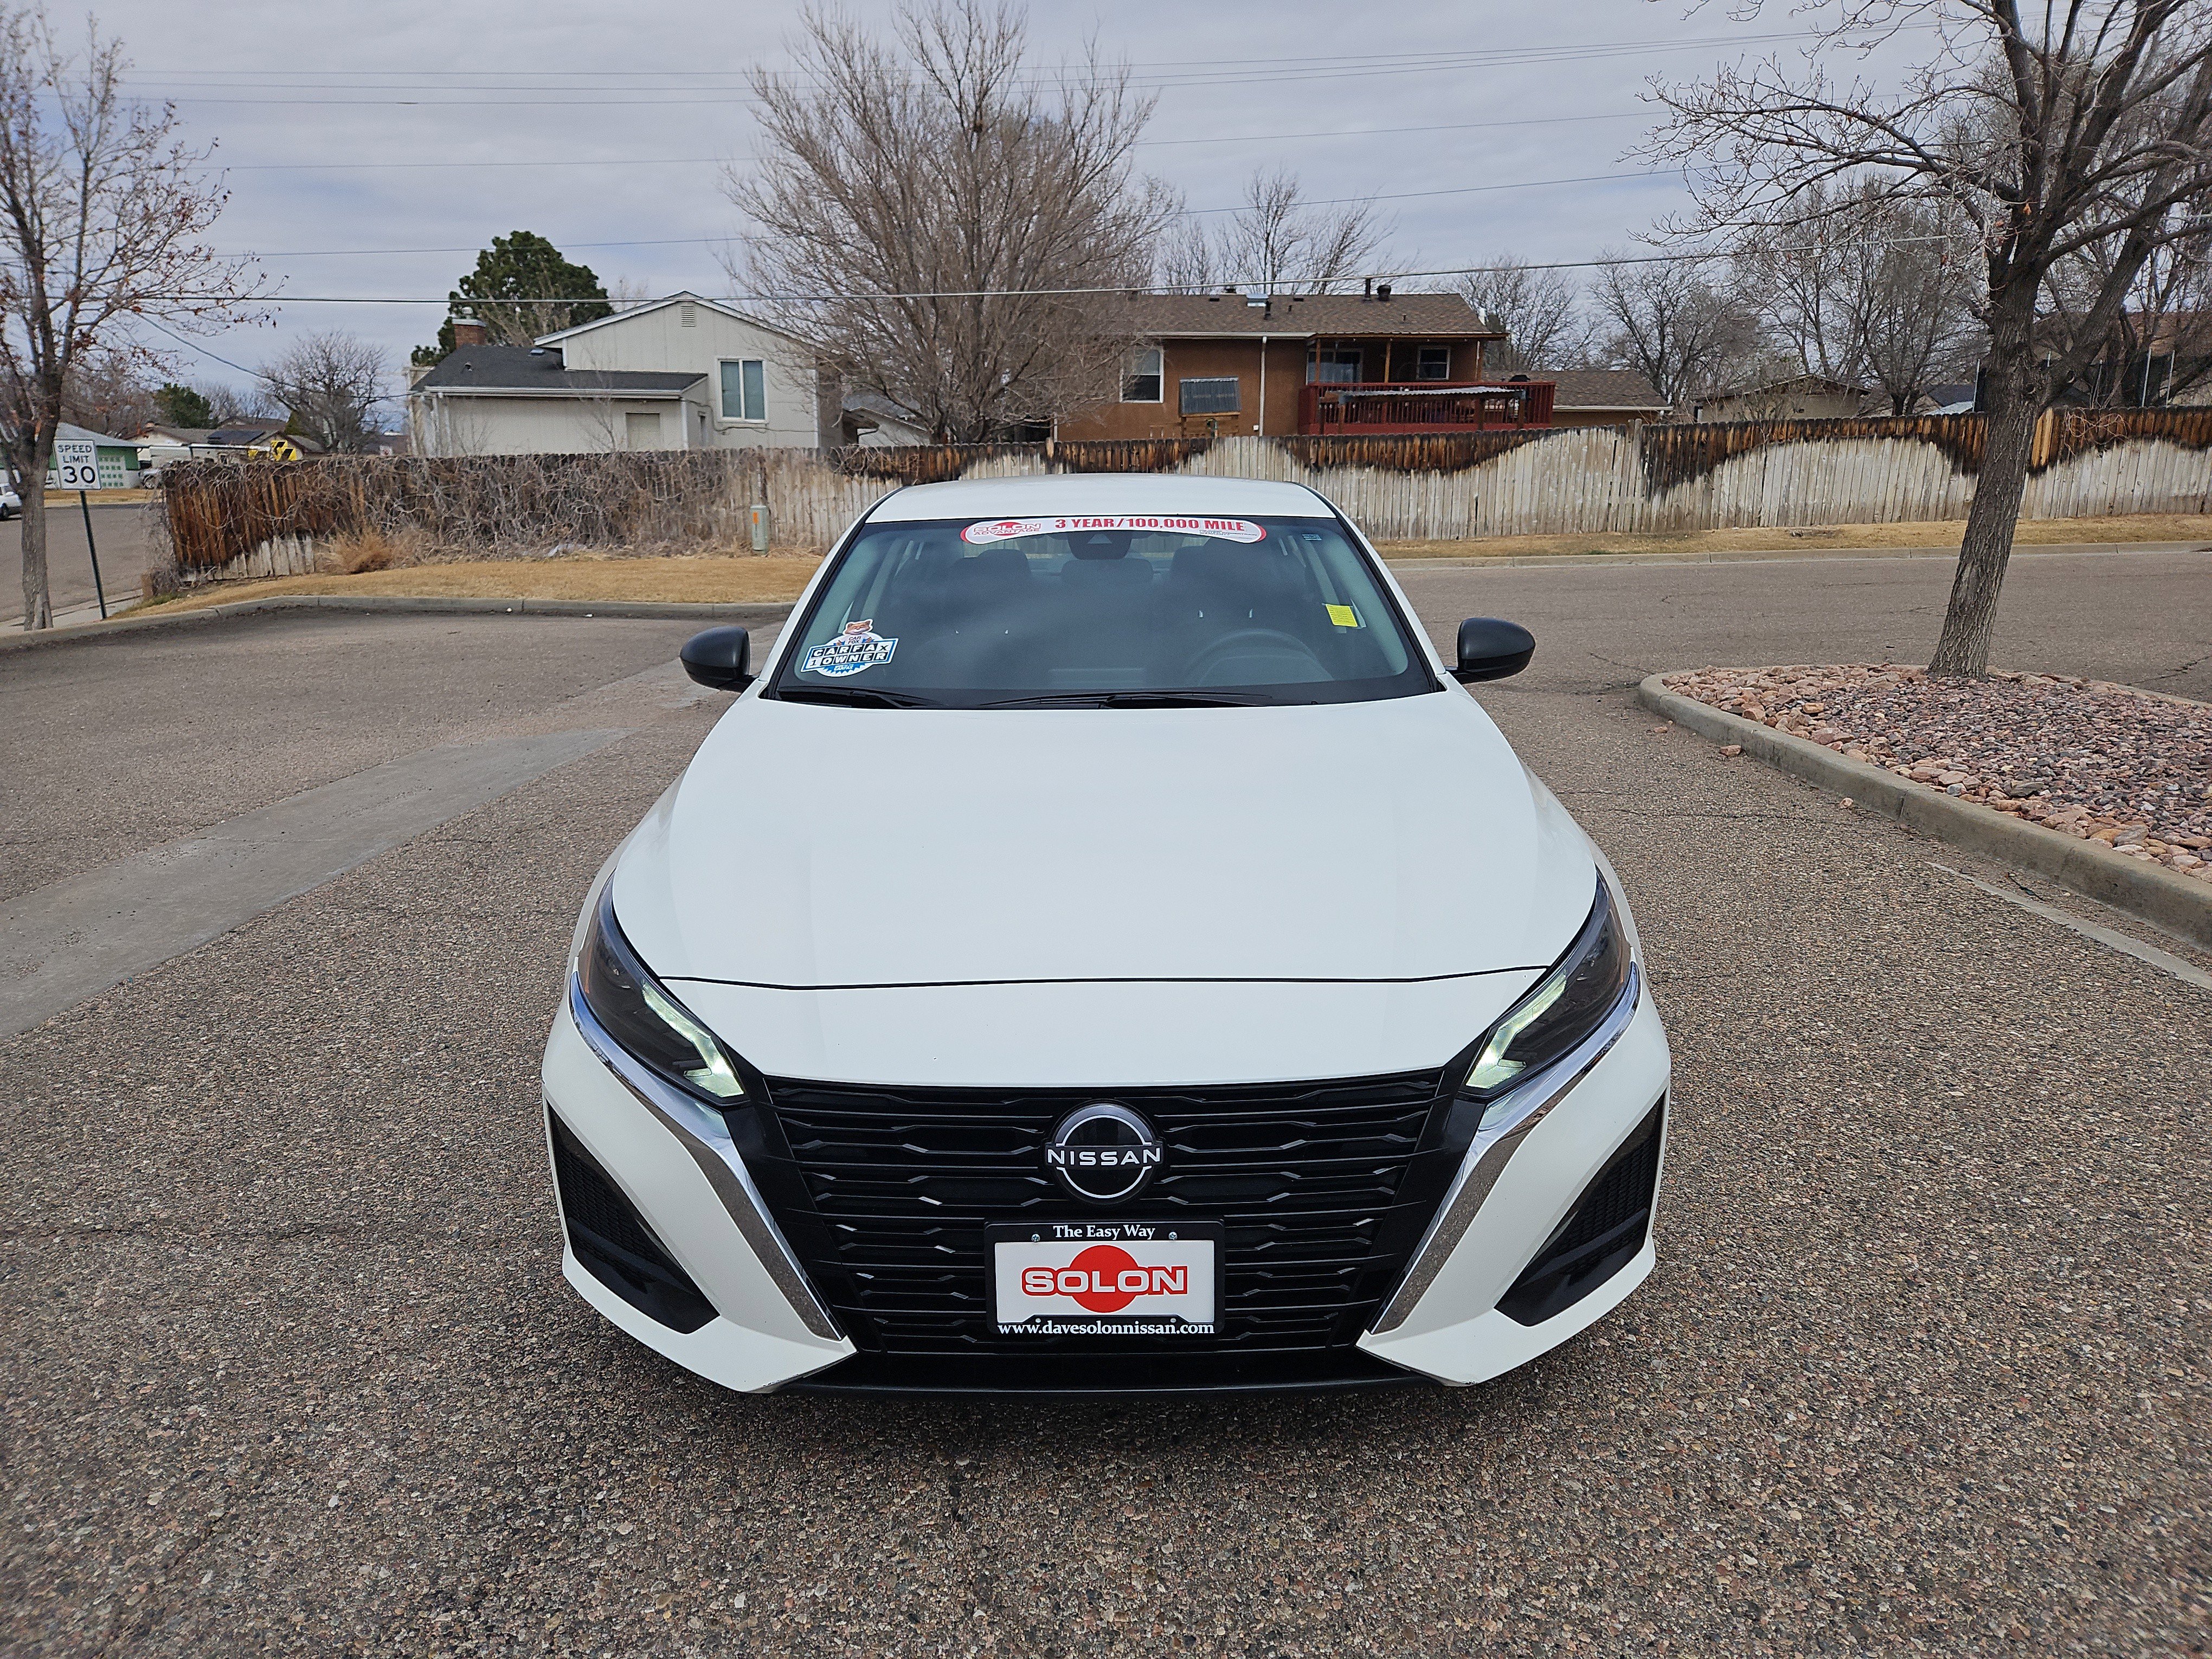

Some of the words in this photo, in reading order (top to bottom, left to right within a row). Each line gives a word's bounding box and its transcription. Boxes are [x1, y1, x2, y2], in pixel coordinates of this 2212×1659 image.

[57, 445, 92, 453] SPEED
[62, 466, 95, 483] 30
[974, 524, 1041, 532] SOLON
[1055, 519, 1066, 528] 3
[1071, 518, 1199, 529] YEAR/100,000
[1204, 520, 1245, 531] MILE
[813, 644, 889, 657] CARFAX
[822, 652, 885, 665] OWNER
[1047, 1147, 1160, 1165] NISSAN
[1053, 1225, 1083, 1237] The
[1086, 1225, 1121, 1240] Easy
[1123, 1224, 1155, 1240] Way
[1023, 1266, 1187, 1296] SOLON
[998, 1321, 1215, 1334] www.davesolonnissan.com
